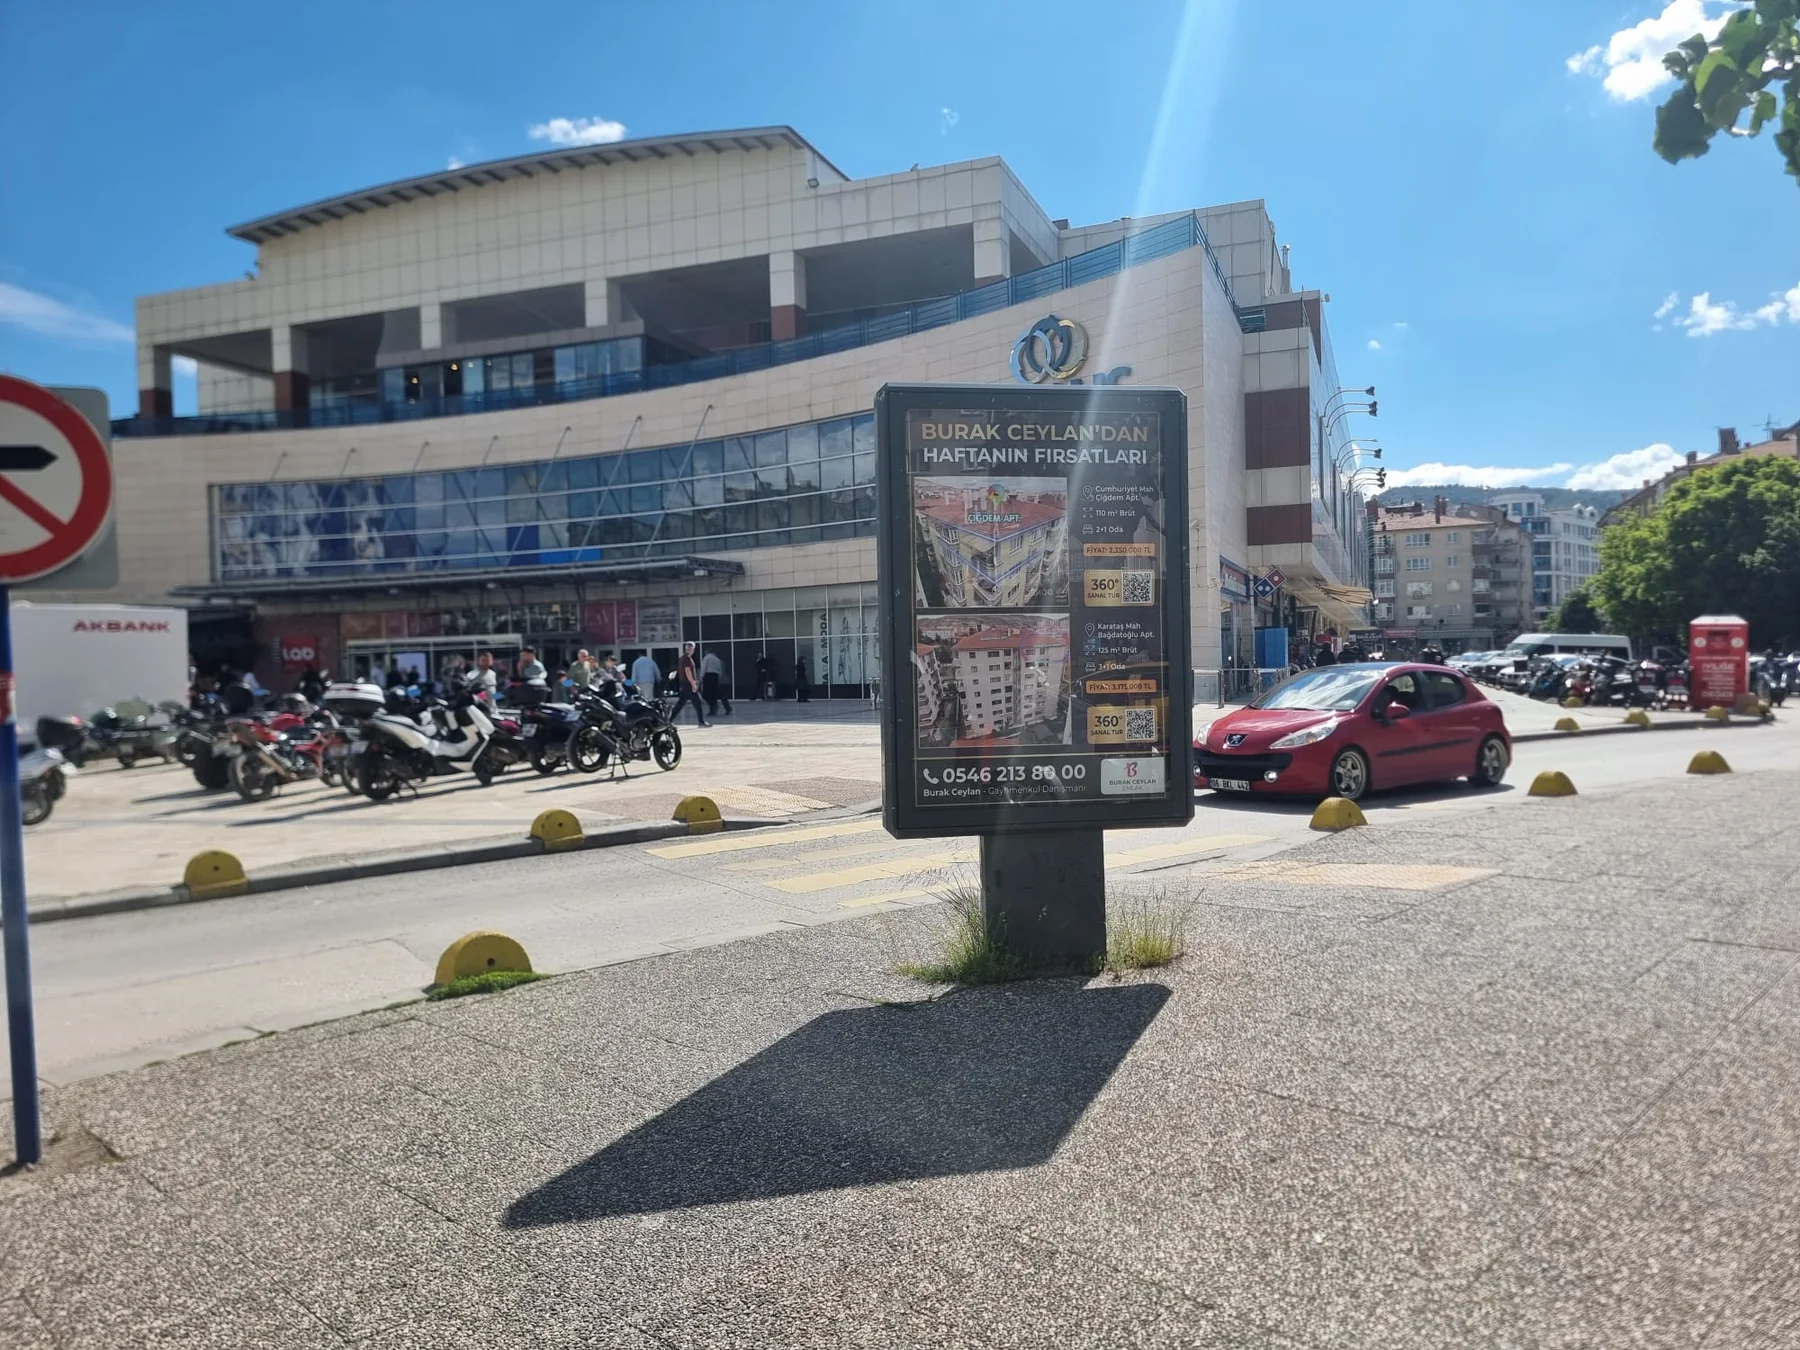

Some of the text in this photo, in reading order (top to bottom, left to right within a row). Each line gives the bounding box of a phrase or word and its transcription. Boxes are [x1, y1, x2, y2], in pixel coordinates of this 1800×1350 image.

[922, 424, 1148, 442] BURAK CEYLAN'DAN
[923, 447, 1148, 464] HAFTANIN FIRSATLARI
[1095, 485, 1138, 494] Cumhuriyet
[1108, 525, 1124, 533] Oda
[73, 619, 170, 633] AKBANK
[942, 764, 1086, 783] 0546 213 80 00
[923, 788, 950, 797] Burak
[951, 787, 981, 797] Ceylan
